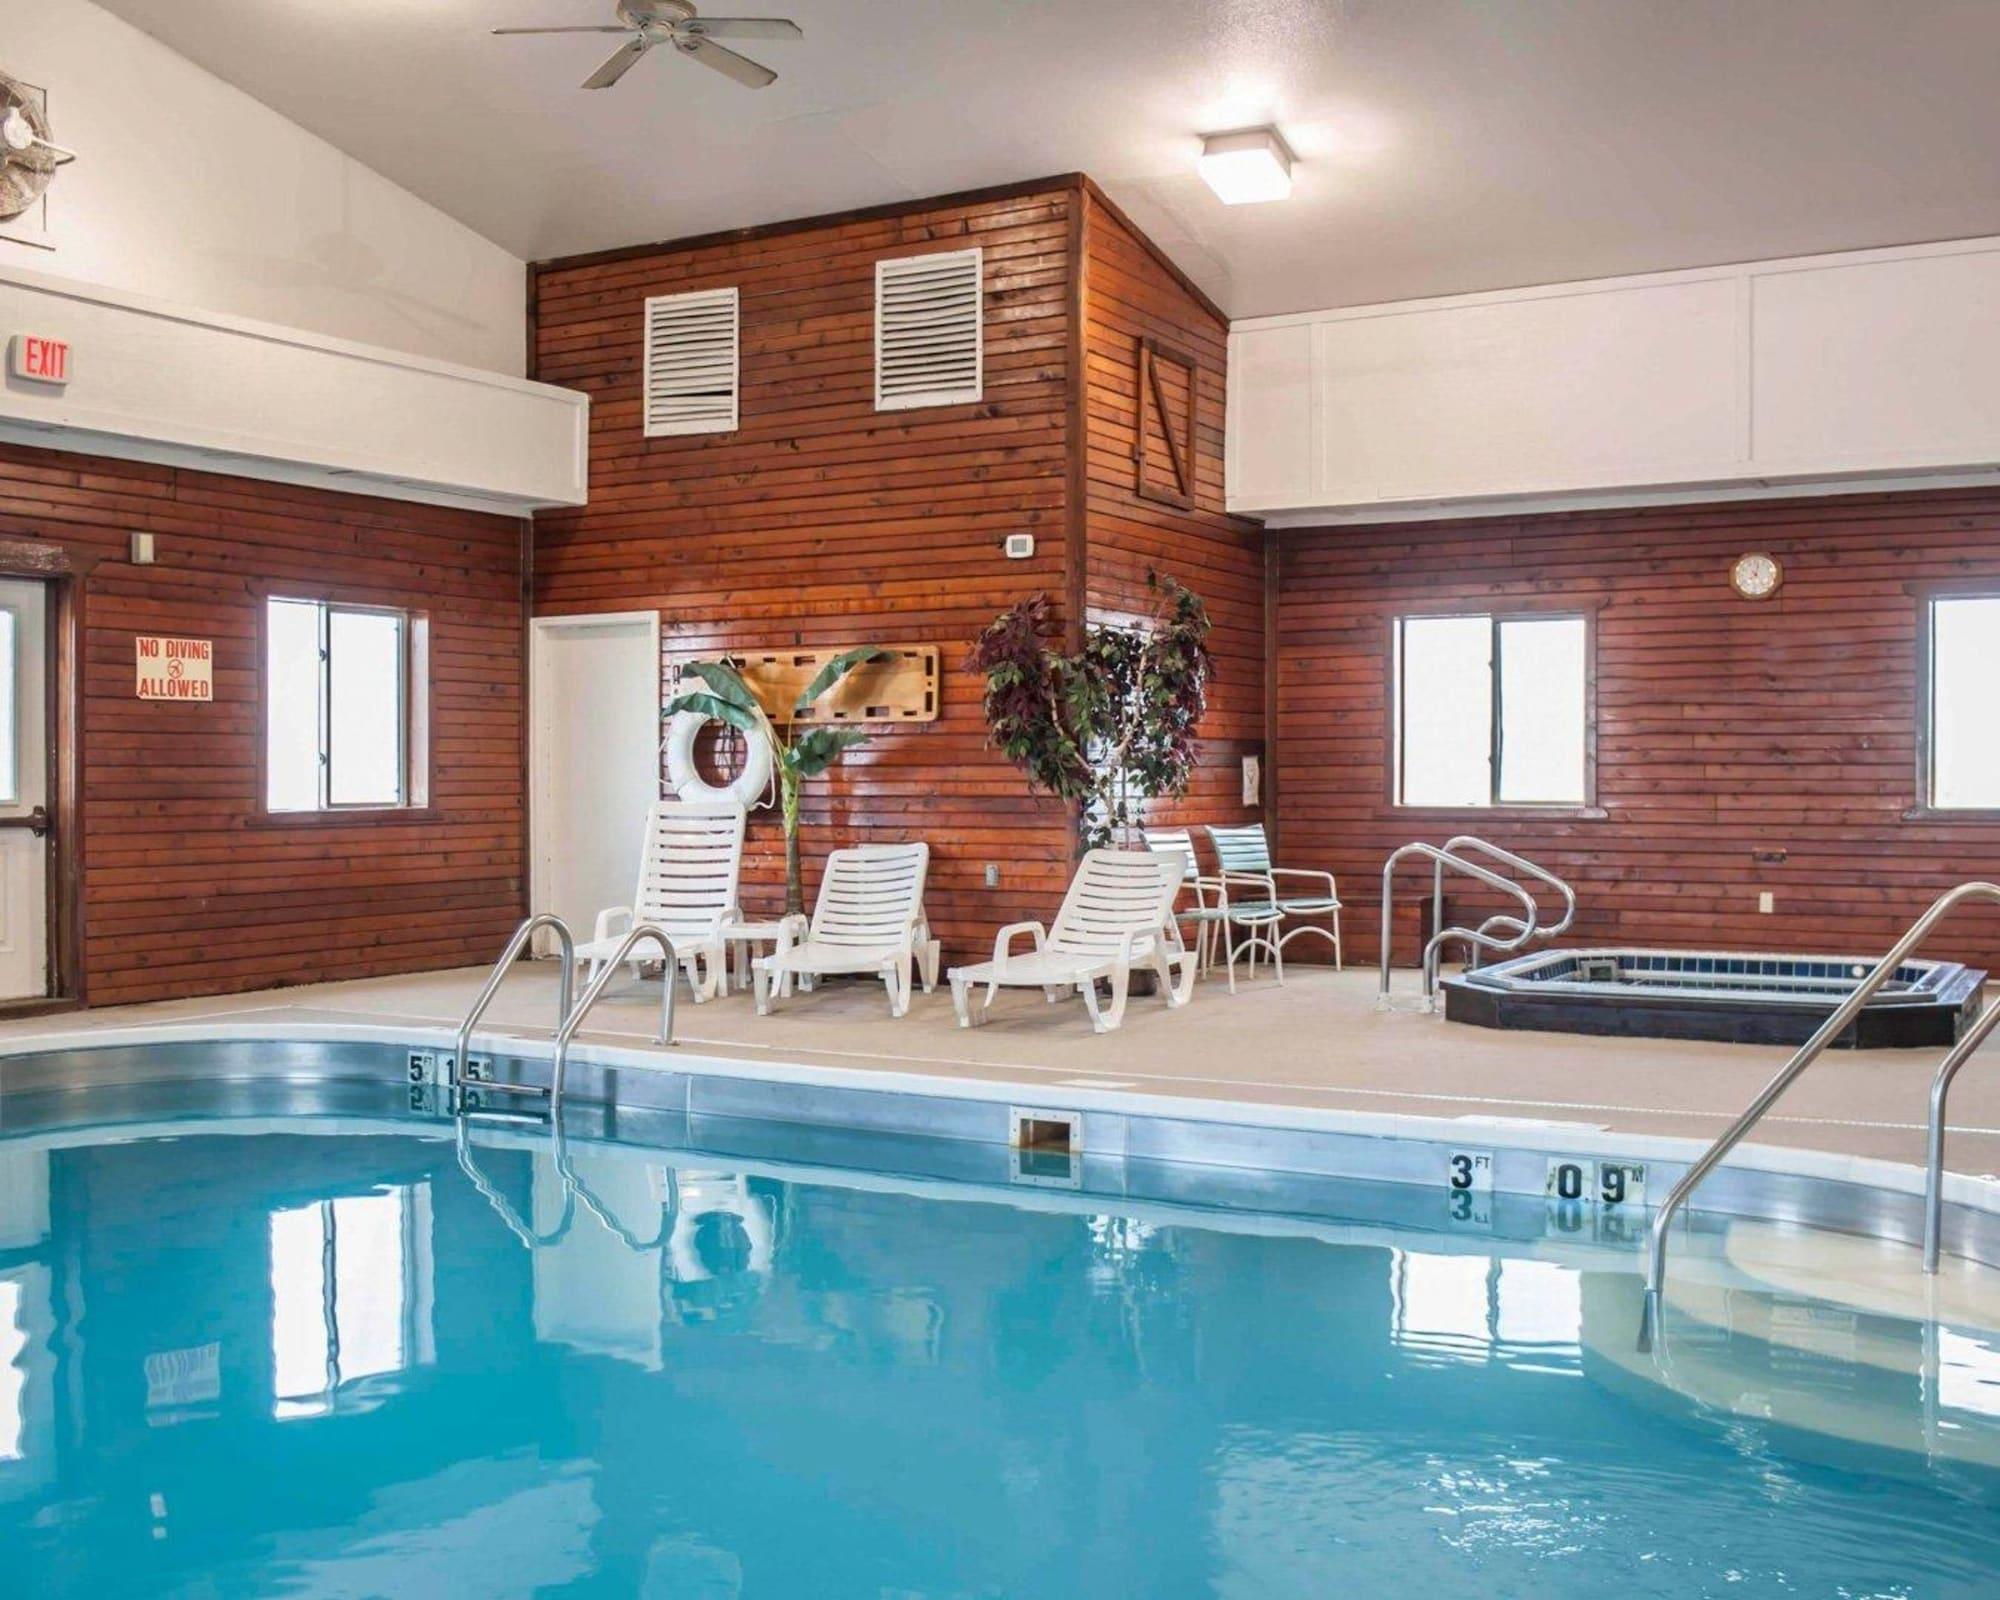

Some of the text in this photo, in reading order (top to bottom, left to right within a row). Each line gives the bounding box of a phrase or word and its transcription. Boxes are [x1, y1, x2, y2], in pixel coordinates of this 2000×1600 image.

[27, 338, 68, 378] EXIT
[140, 639, 209, 659] NO DIVING
[139, 678, 209, 697] ALLOWED
[410, 1056, 423, 1081] 5
[1451, 1155, 1490, 1189] 3 FT
